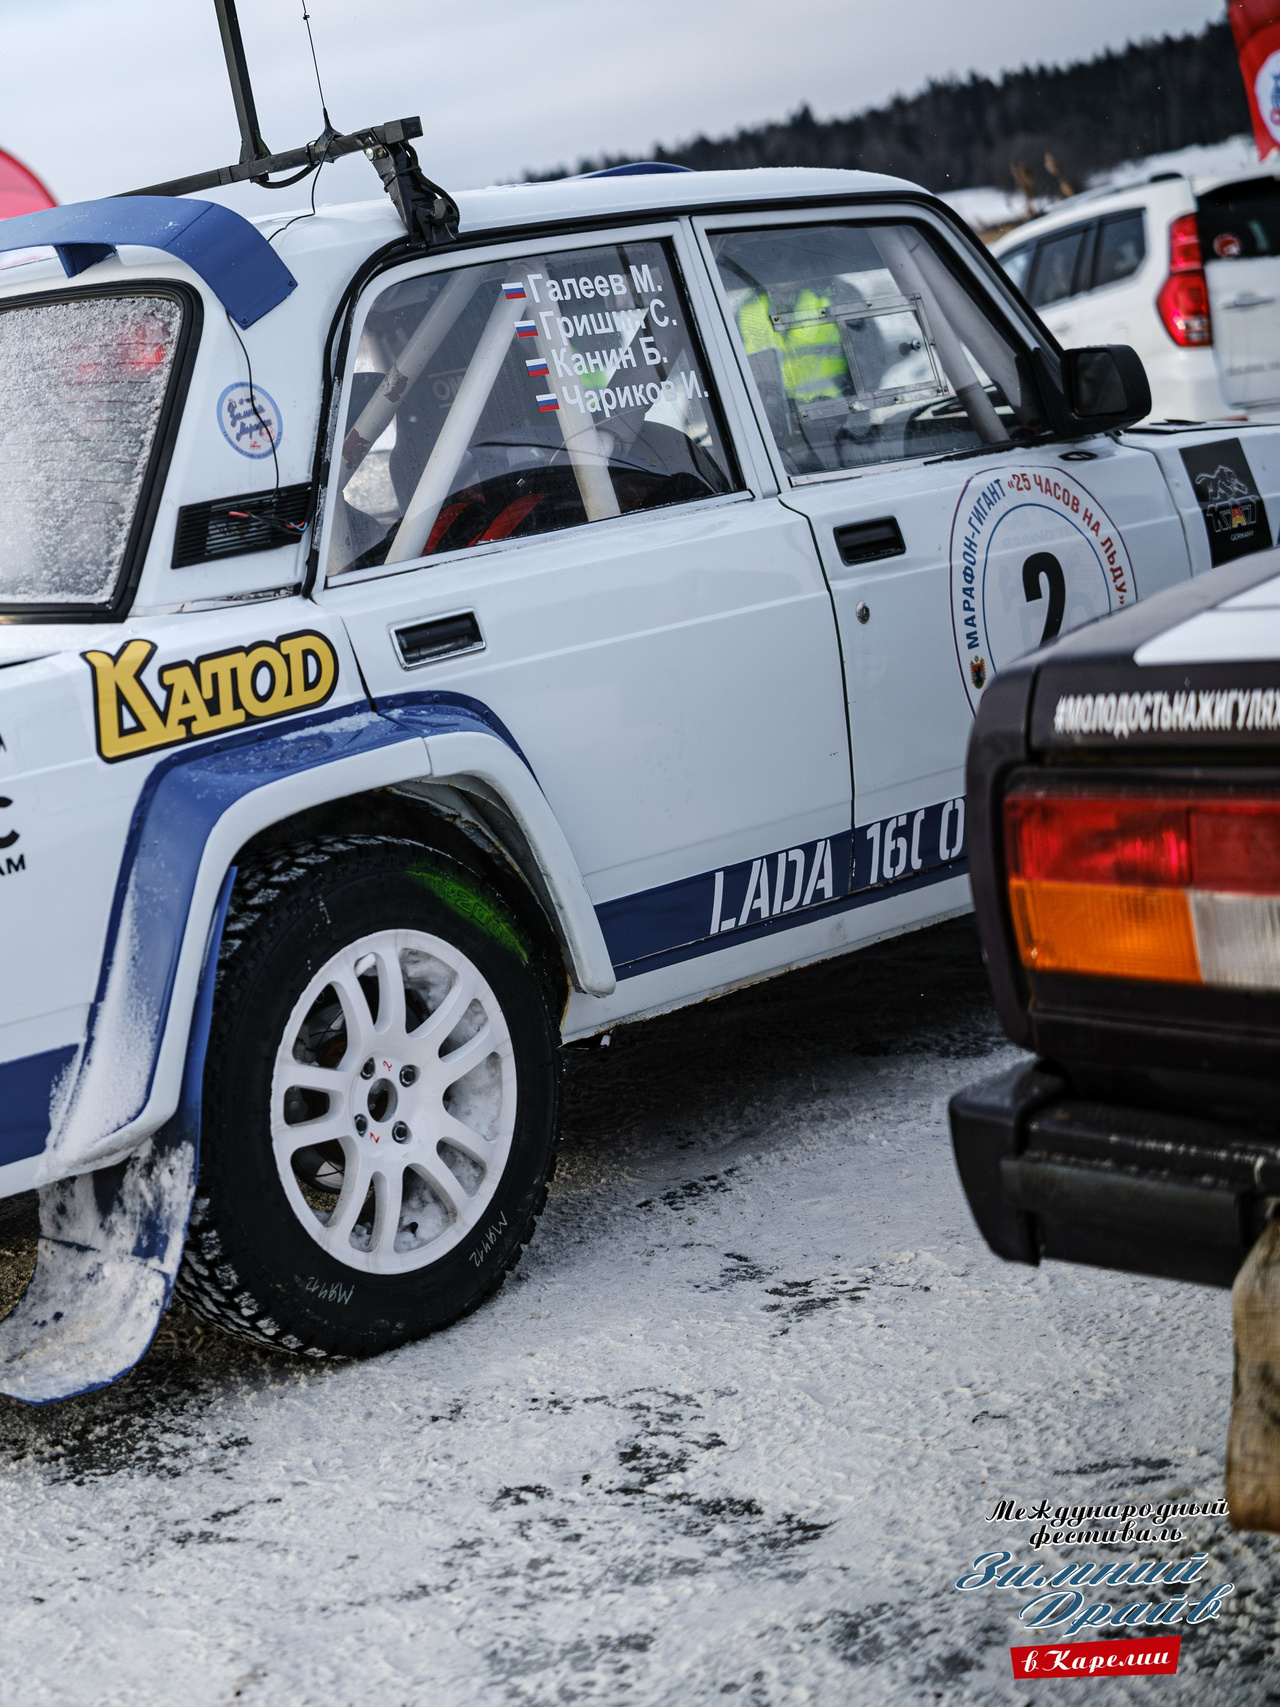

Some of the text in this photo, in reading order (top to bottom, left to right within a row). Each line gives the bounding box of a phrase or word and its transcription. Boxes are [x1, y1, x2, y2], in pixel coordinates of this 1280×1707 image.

[527, 264, 662, 303] Галеев М.
[539, 299, 677, 346] Гришин С.
[551, 336, 668, 378] Канин Б.
[562, 370, 709, 418] Чариков И.
[1229, 530, 1255, 542] GERMANY
[961, 478, 1007, 650] МАРАФОН-ГИГАНТ
[1033, 474, 1081, 514] ЧАСОВ
[1082, 507, 1102, 537] НА
[1022, 552, 1066, 648] 2
[710, 838, 833, 936] LADA
